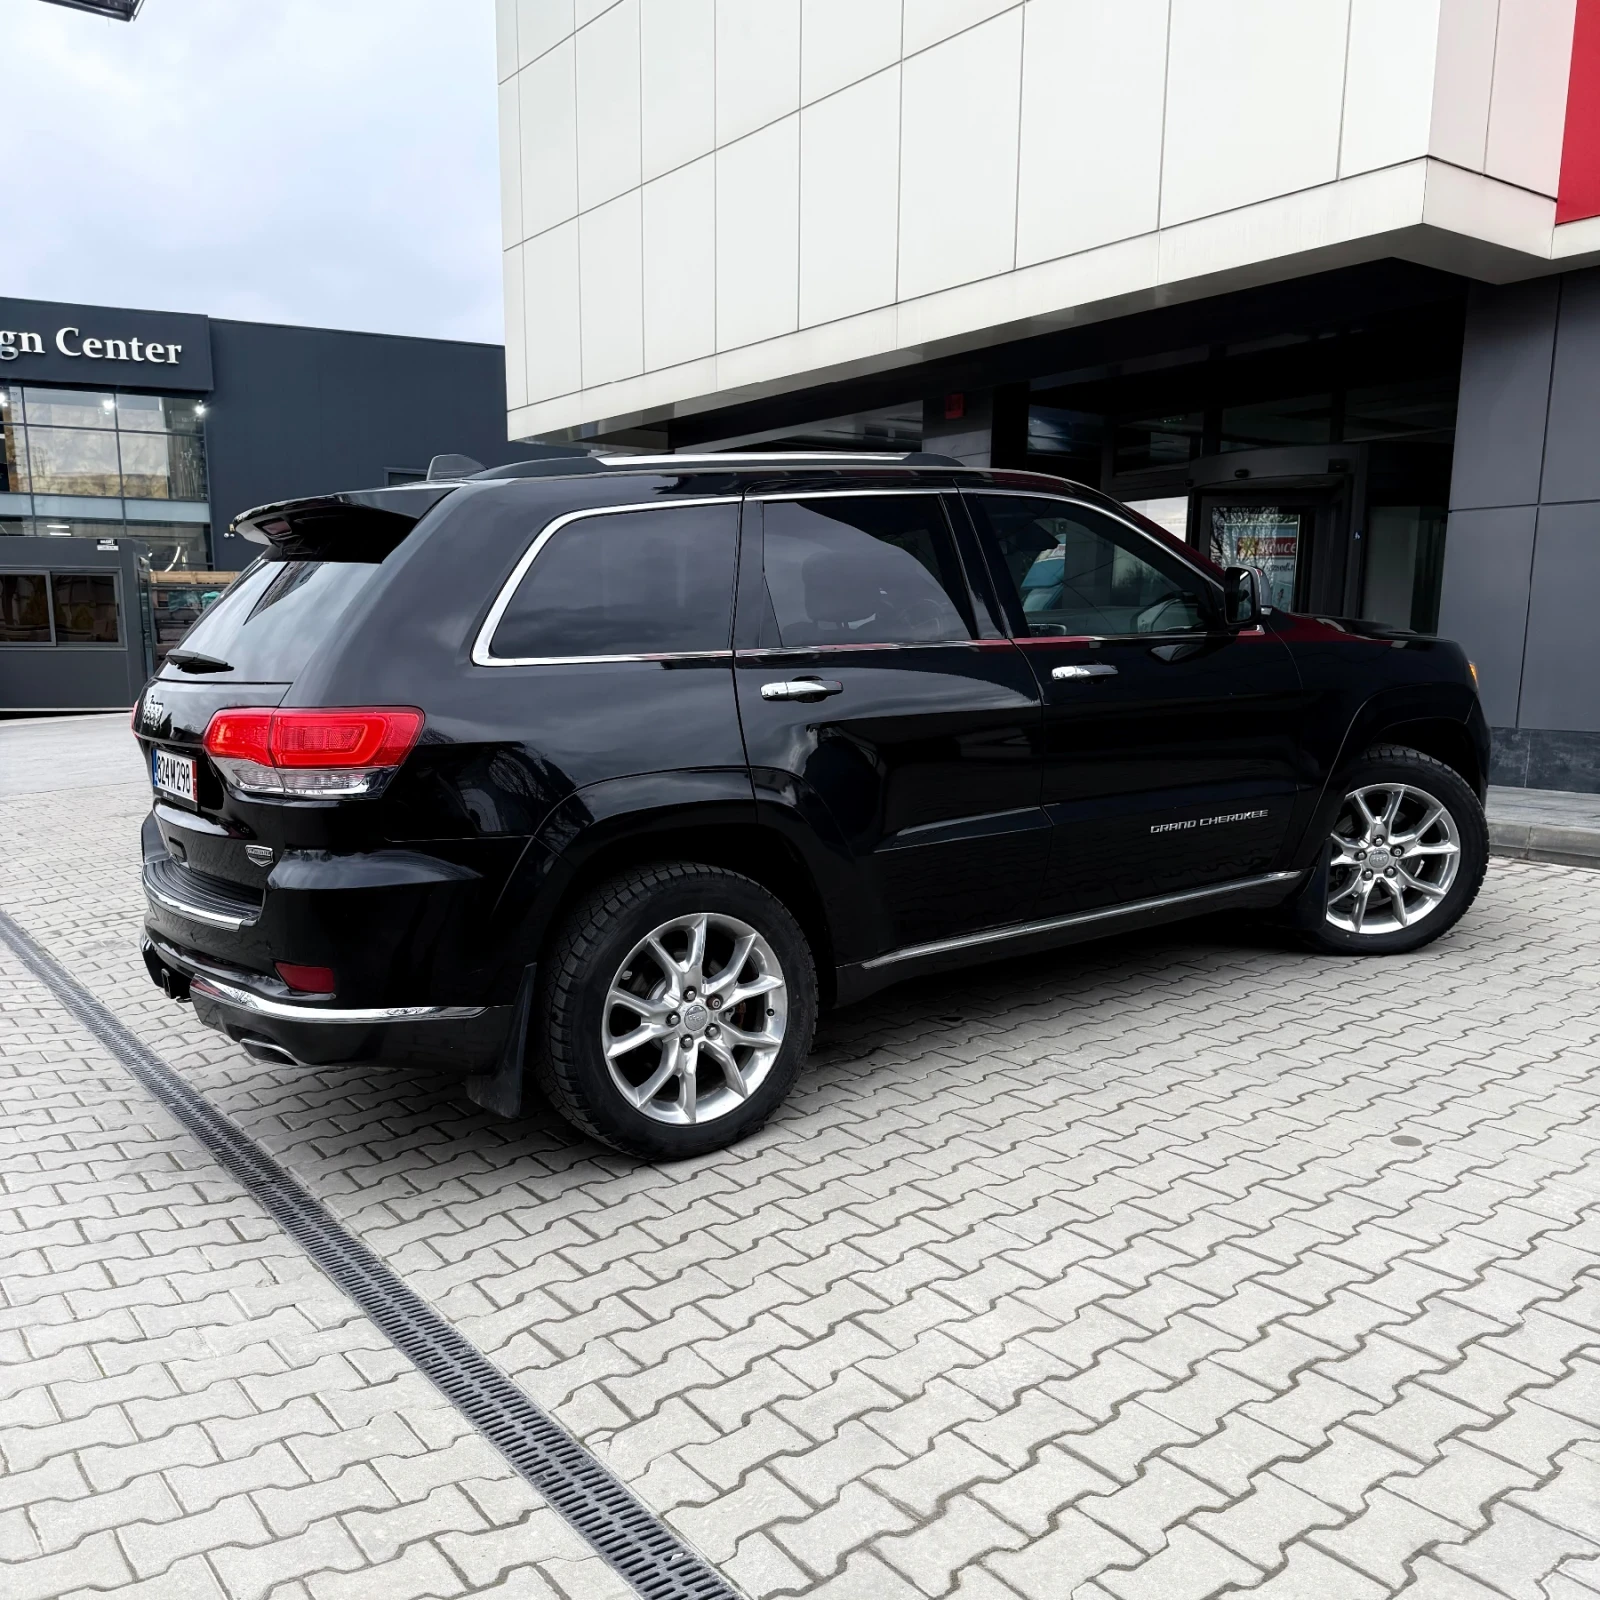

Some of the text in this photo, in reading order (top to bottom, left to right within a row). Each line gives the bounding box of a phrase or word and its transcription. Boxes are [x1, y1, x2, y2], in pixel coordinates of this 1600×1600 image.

[0, 327, 182, 364] gn Center
[1150, 809, 1269, 833] GRAND CHEROKEE
